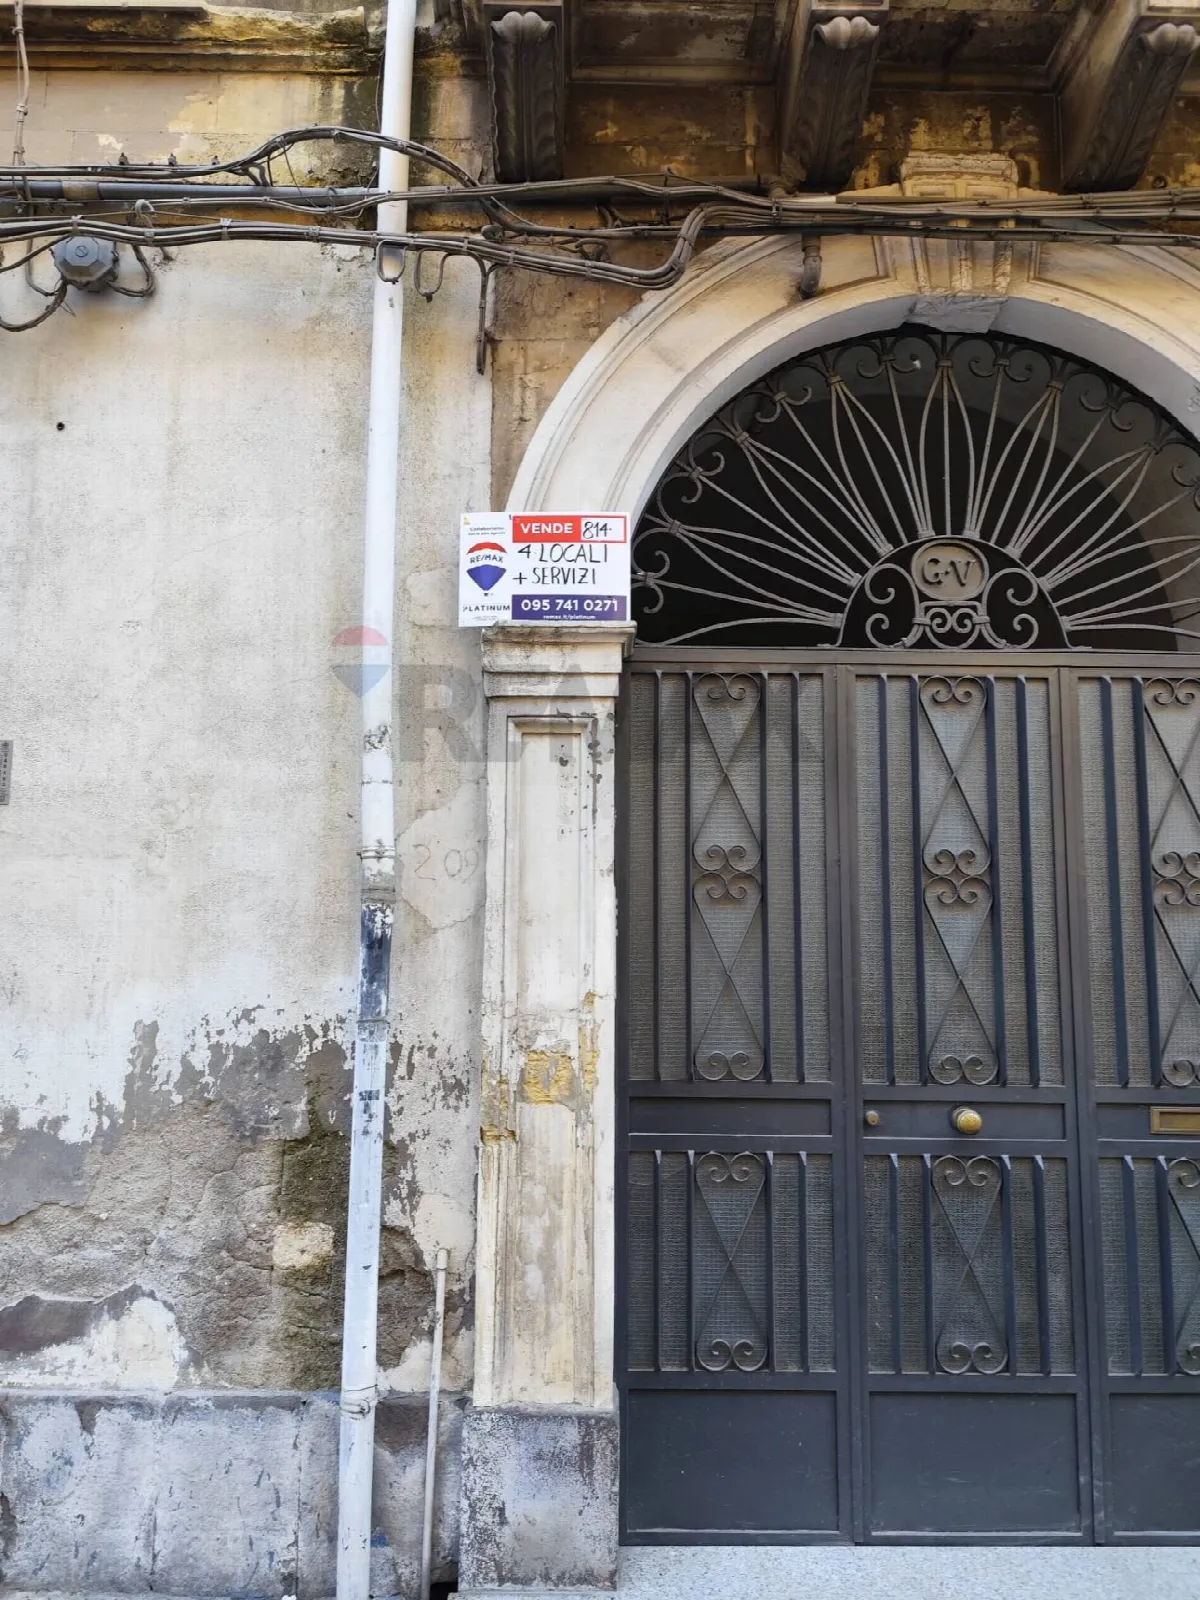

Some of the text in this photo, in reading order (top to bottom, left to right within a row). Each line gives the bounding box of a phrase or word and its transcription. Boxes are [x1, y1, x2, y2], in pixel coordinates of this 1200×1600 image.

[520, 523, 573, 534] VENDE
[469, 553, 504, 564] RE/MAX
[517, 543, 608, 564] 4 LOCALI
[512, 566, 596, 585] + SERVIZI
[521, 598, 618, 612] 095 741 0271
